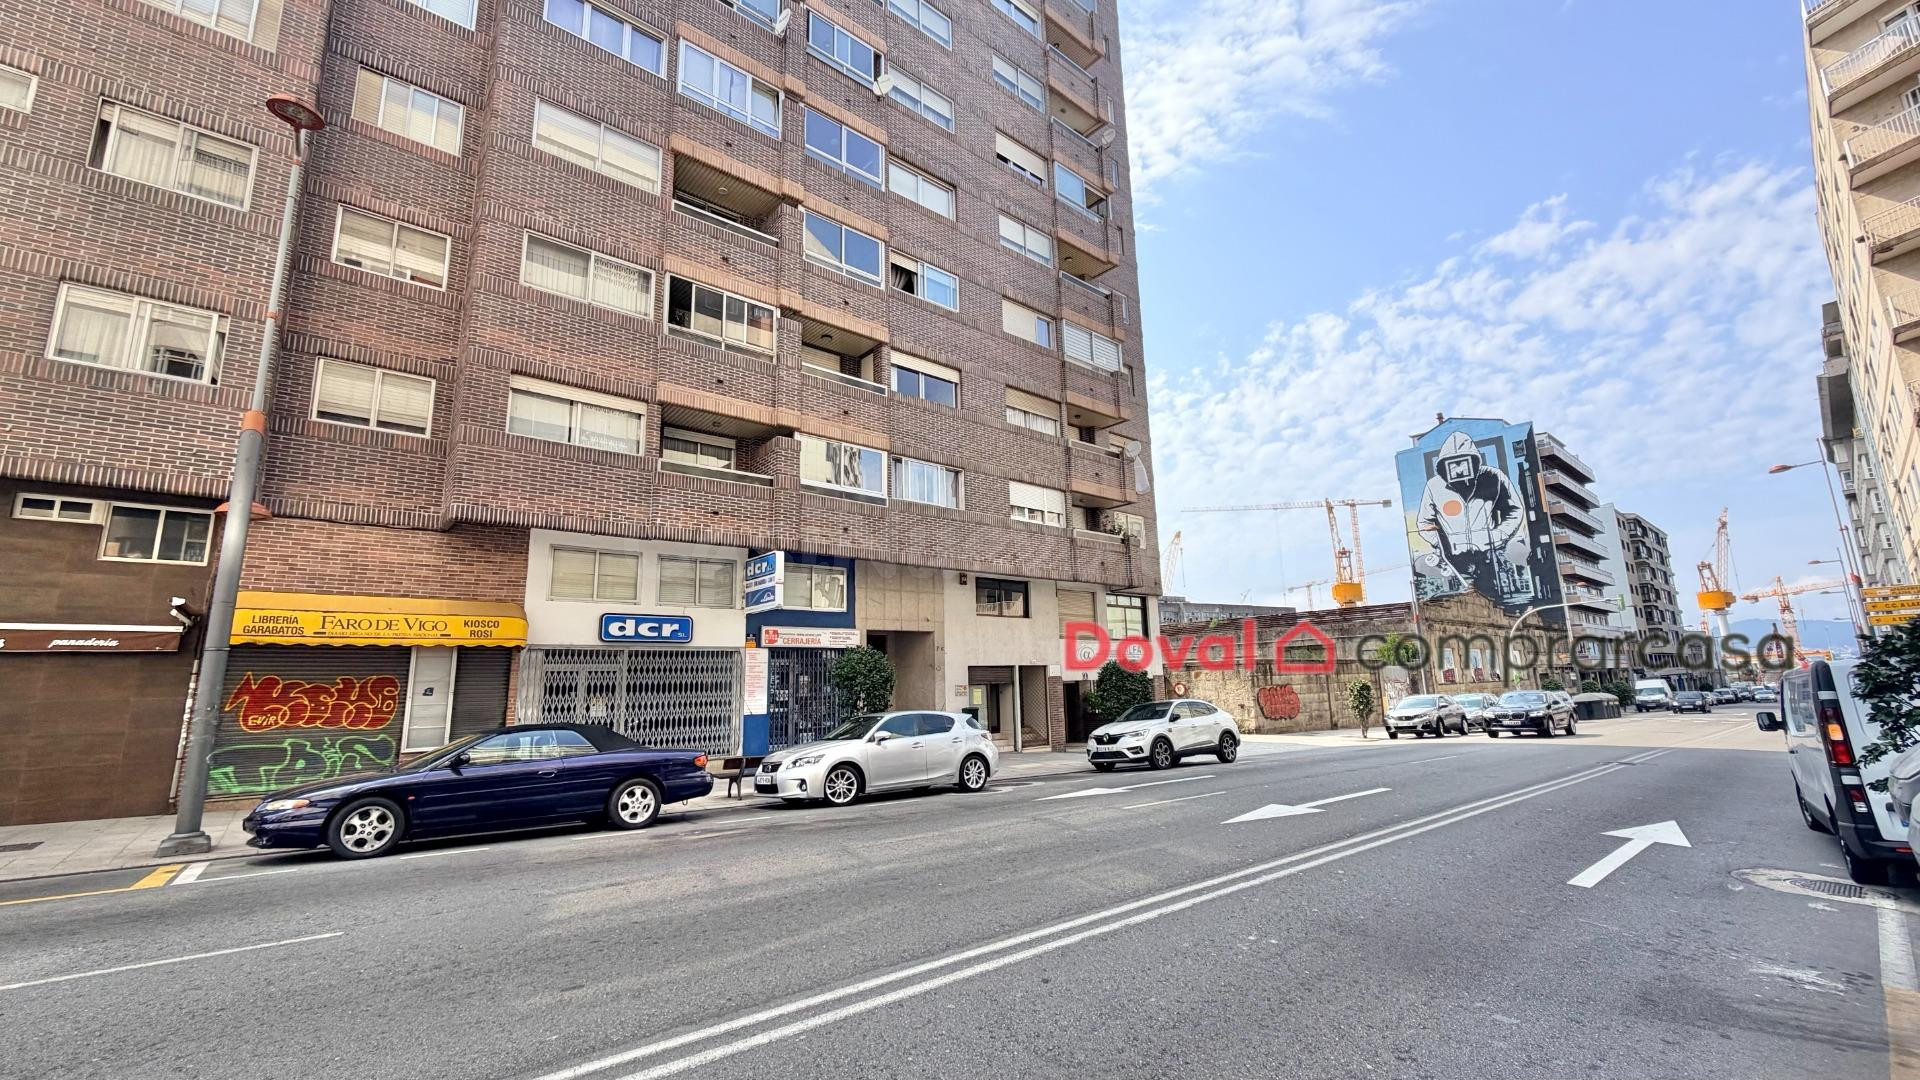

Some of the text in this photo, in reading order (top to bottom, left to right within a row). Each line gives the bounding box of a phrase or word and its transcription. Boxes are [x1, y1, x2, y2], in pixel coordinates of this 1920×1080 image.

[747, 561, 767, 577] dcr
[252, 615, 299, 625] LIBRERÍA
[320, 615, 448, 632] FARO DE VIGO
[463, 619, 500, 628] KIOSCO
[243, 625, 305, 635] GARABATOS
[608, 619, 680, 637] dcr
[470, 629, 493, 638] ROSI
[782, 636, 822, 645] CERRAJERÍA
